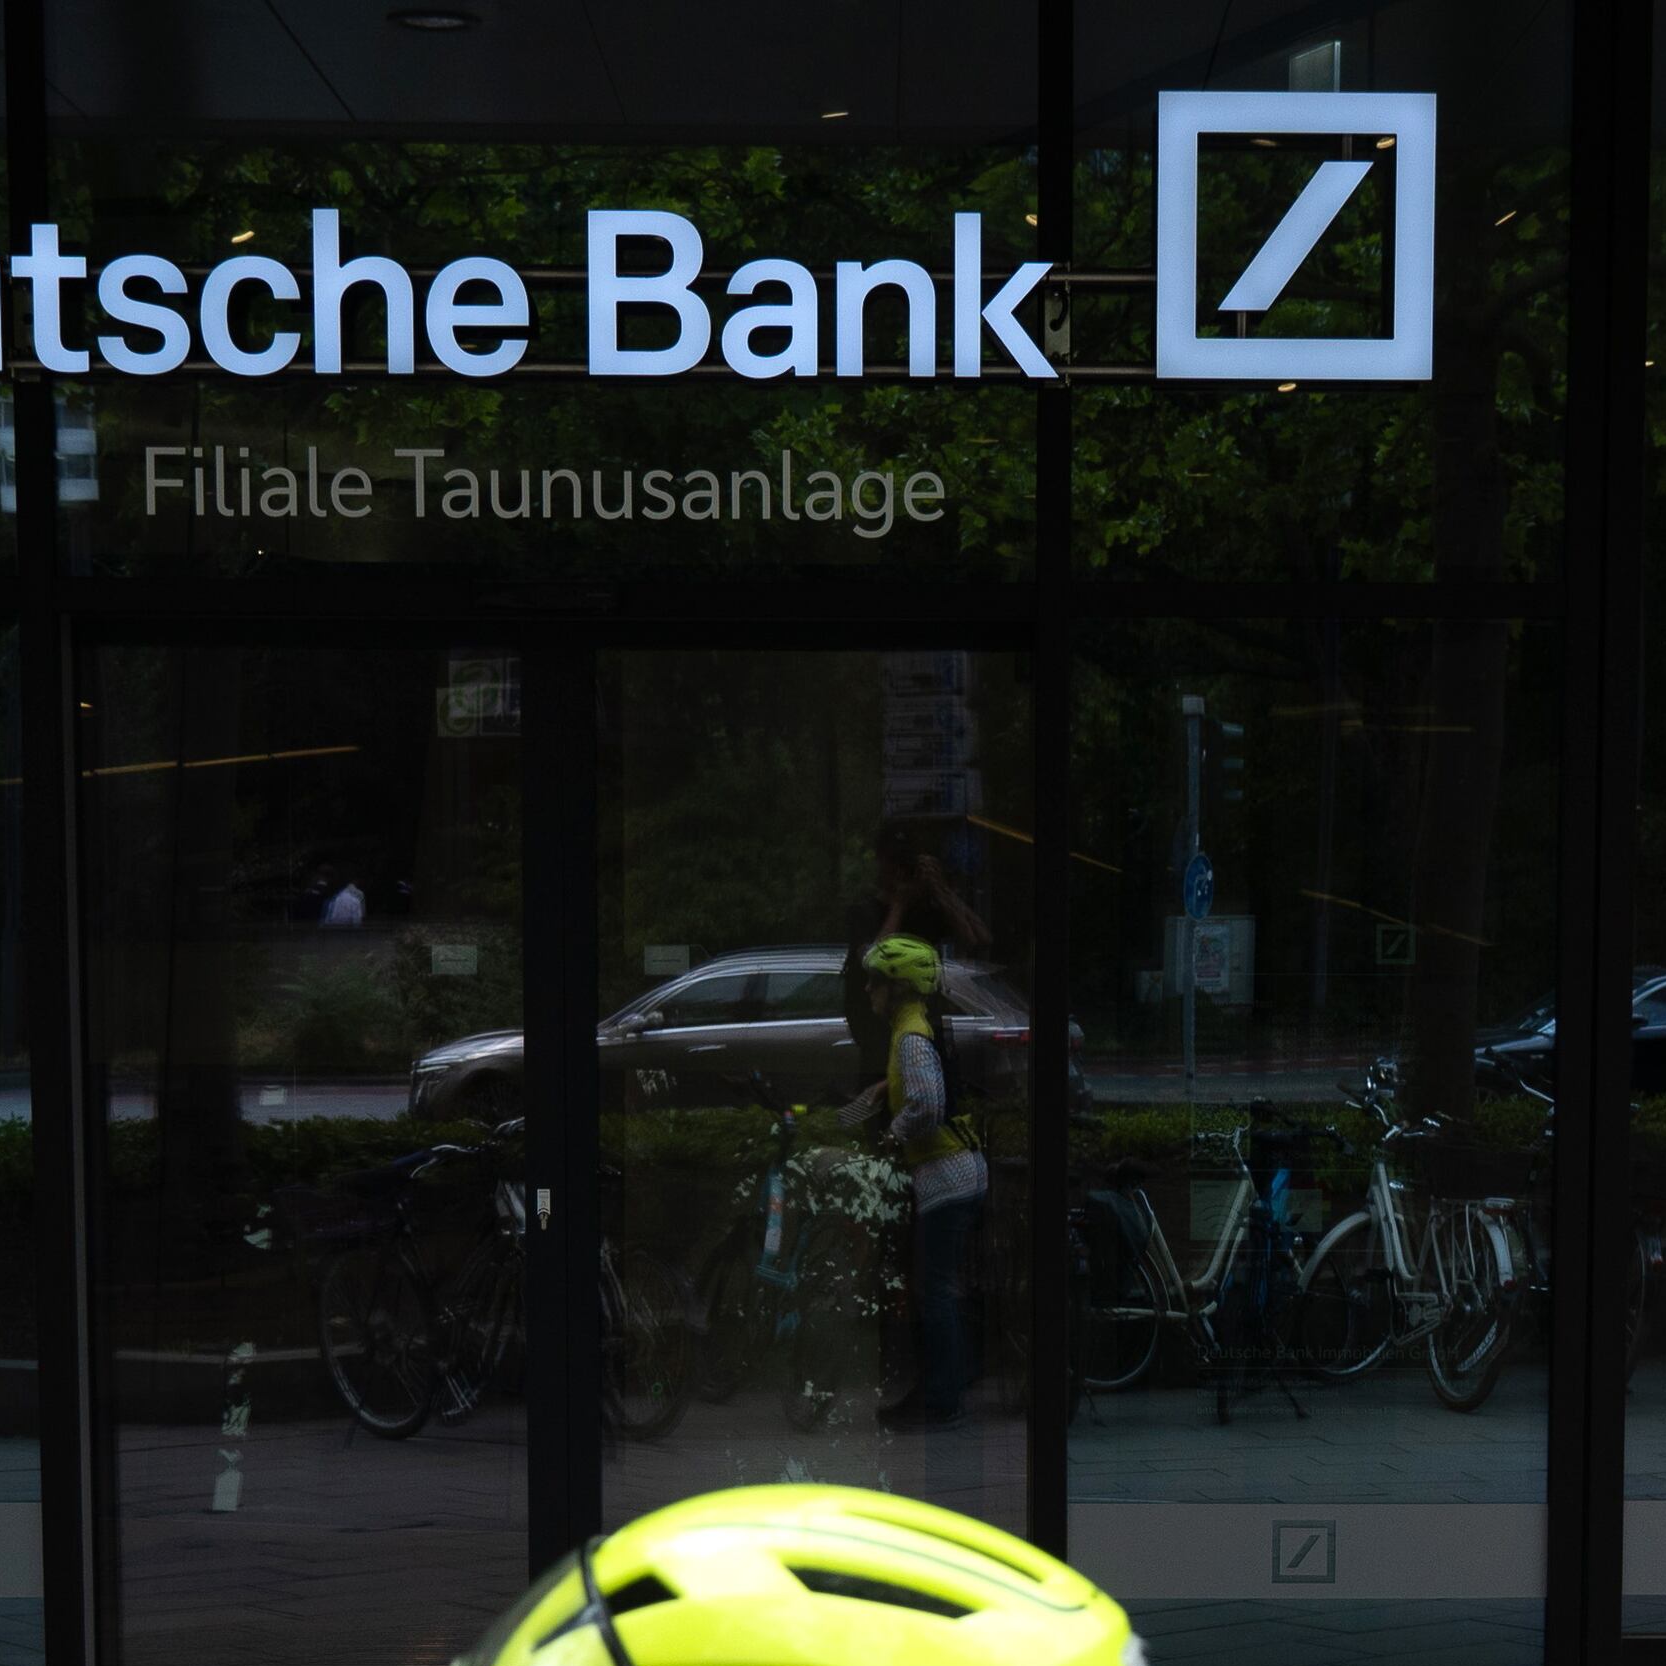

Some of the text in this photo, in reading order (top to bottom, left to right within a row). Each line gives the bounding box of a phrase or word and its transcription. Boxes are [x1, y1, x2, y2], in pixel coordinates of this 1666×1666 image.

[587, 210, 1060, 379] Bank
[144, 445, 946, 540] Filiale Taunusanlage
